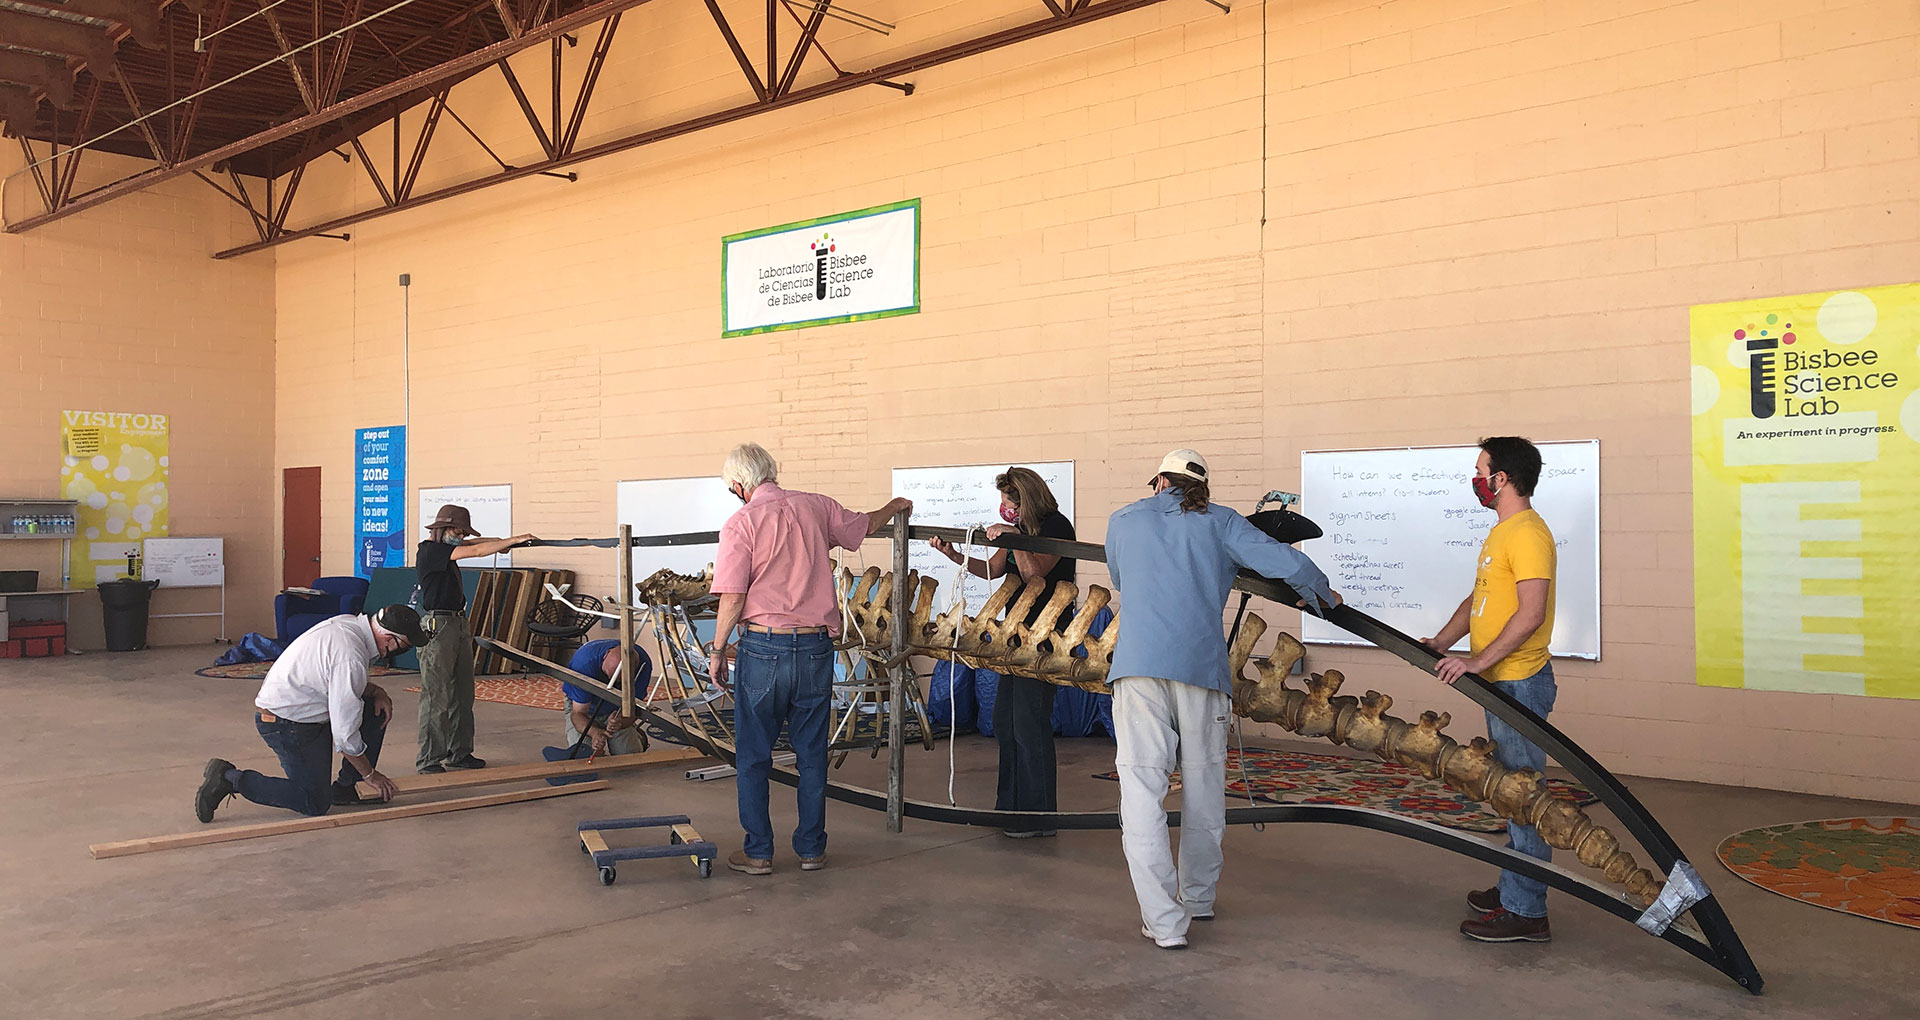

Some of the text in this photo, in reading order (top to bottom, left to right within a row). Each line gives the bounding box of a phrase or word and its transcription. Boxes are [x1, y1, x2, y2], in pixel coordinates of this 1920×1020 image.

[830, 254, 867, 269] Bisbee
[759, 261, 814, 279] Laboratorio
[830, 268, 873, 284] Science
[759, 276, 814, 294] de Ciencias
[830, 285, 851, 299] Lab
[768, 291, 813, 306] de Bisbee
[1784, 349, 1878, 371] Bisbee
[1784, 372, 1898, 394] Science
[1784, 396, 1839, 417] Lab
[63, 410, 166, 430] VISITOR
[363, 429, 390, 441] step out
[1737, 424, 1897, 440] An experiment in progress.
[363, 441, 389, 455] of your
[363, 454, 389, 464] comfort
[363, 468, 389, 481] zone
[1332, 464, 1354, 480] How
[1359, 472, 1379, 480] can
[1411, 467, 1467, 484] effectively
[362, 482, 388, 493] and open
[362, 494, 388, 504] your mind
[362, 506, 388, 516] to new
[362, 519, 388, 532] ideas!
